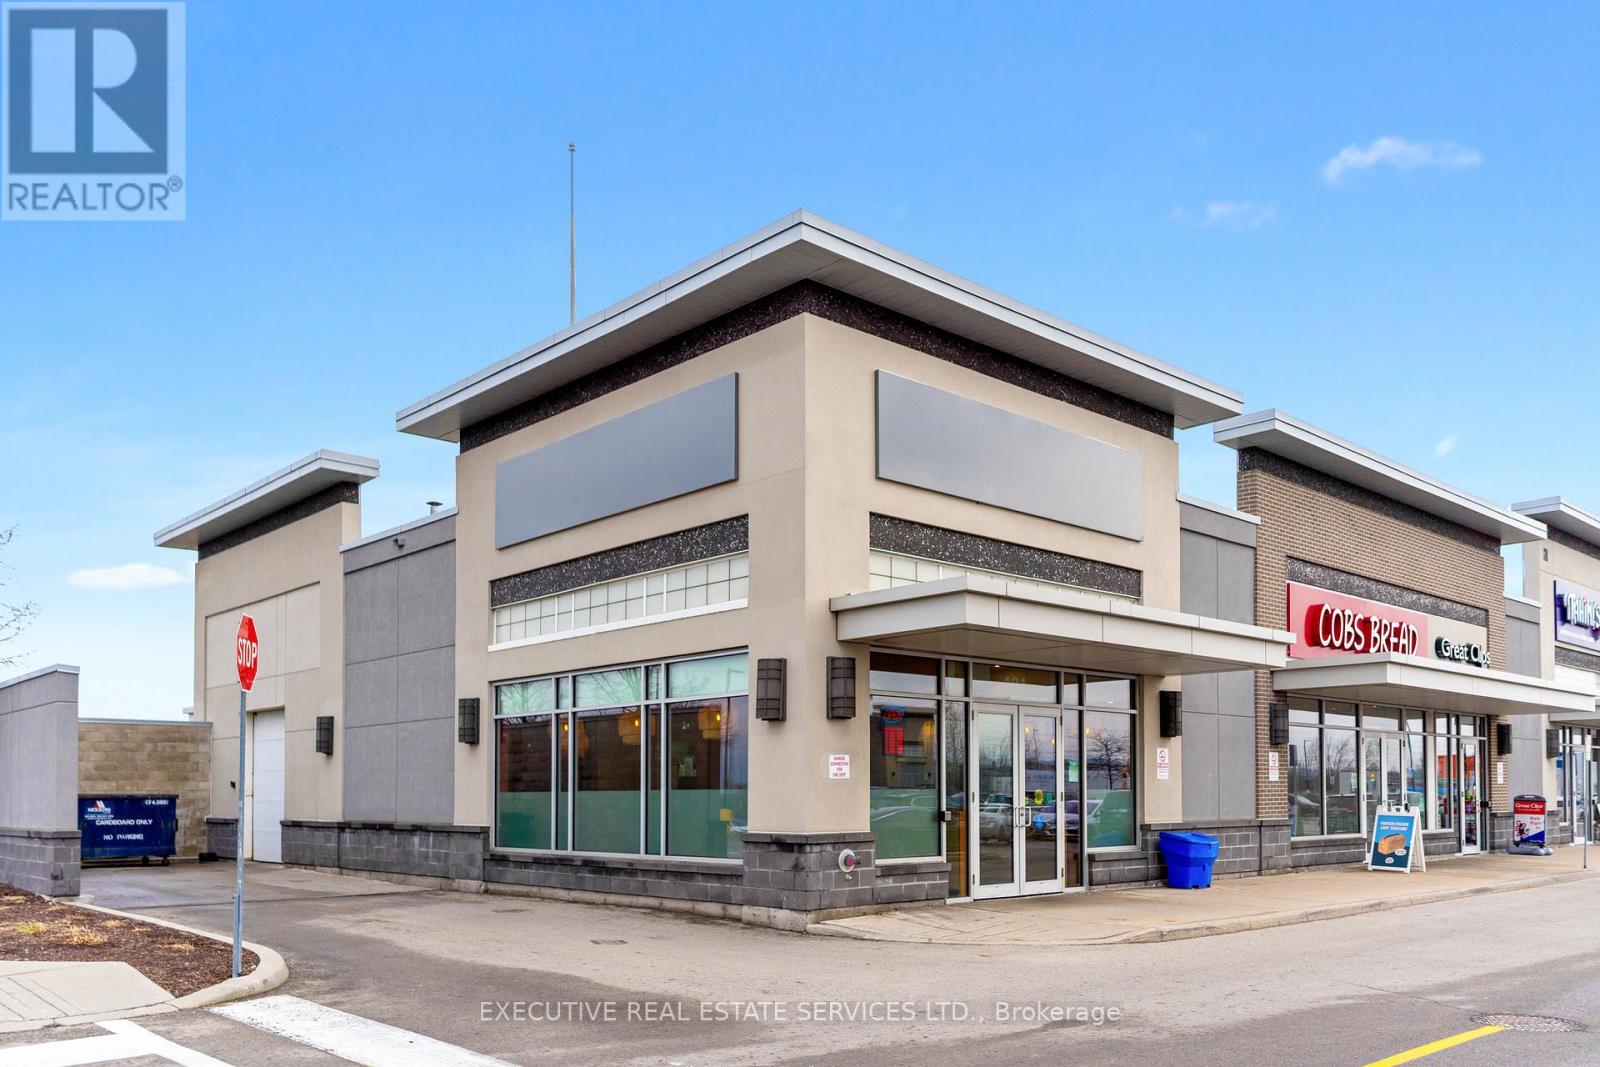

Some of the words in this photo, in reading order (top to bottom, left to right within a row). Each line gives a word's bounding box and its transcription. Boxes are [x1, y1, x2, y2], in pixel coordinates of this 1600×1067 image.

[1319, 603, 1365, 651] COBS
[1369, 615, 1419, 657] BREAD
[238, 637, 257, 668] STOP
[1441, 637, 1469, 661] Great
